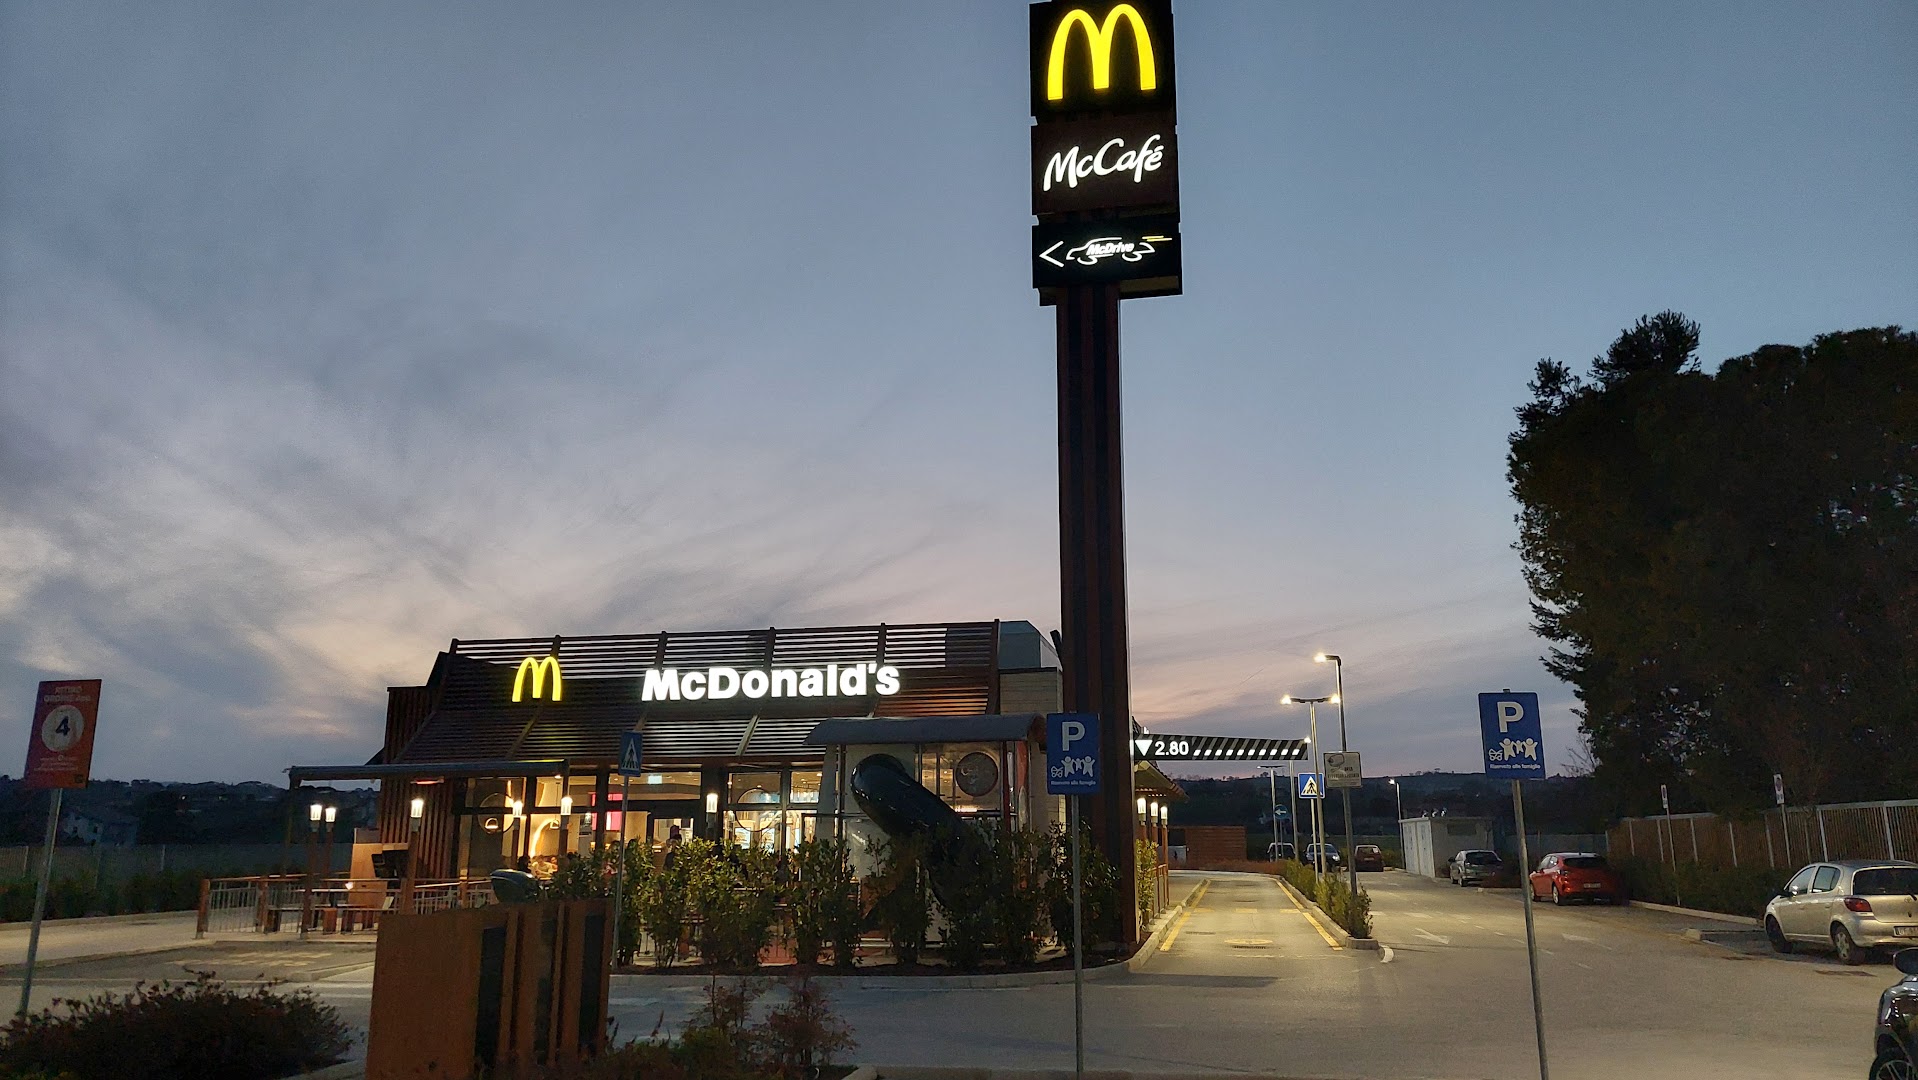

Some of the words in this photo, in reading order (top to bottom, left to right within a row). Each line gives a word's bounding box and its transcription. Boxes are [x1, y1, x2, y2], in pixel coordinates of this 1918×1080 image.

[1043, 134, 1164, 192] McCafé
[1085, 242, 1135, 256] McDrive
[641, 663, 901, 701] McDonald's
[55, 715, 71, 737] 4
[1496, 701, 1524, 733] P
[1061, 721, 1086, 752] P
[1154, 740, 1190, 756] 2.80
